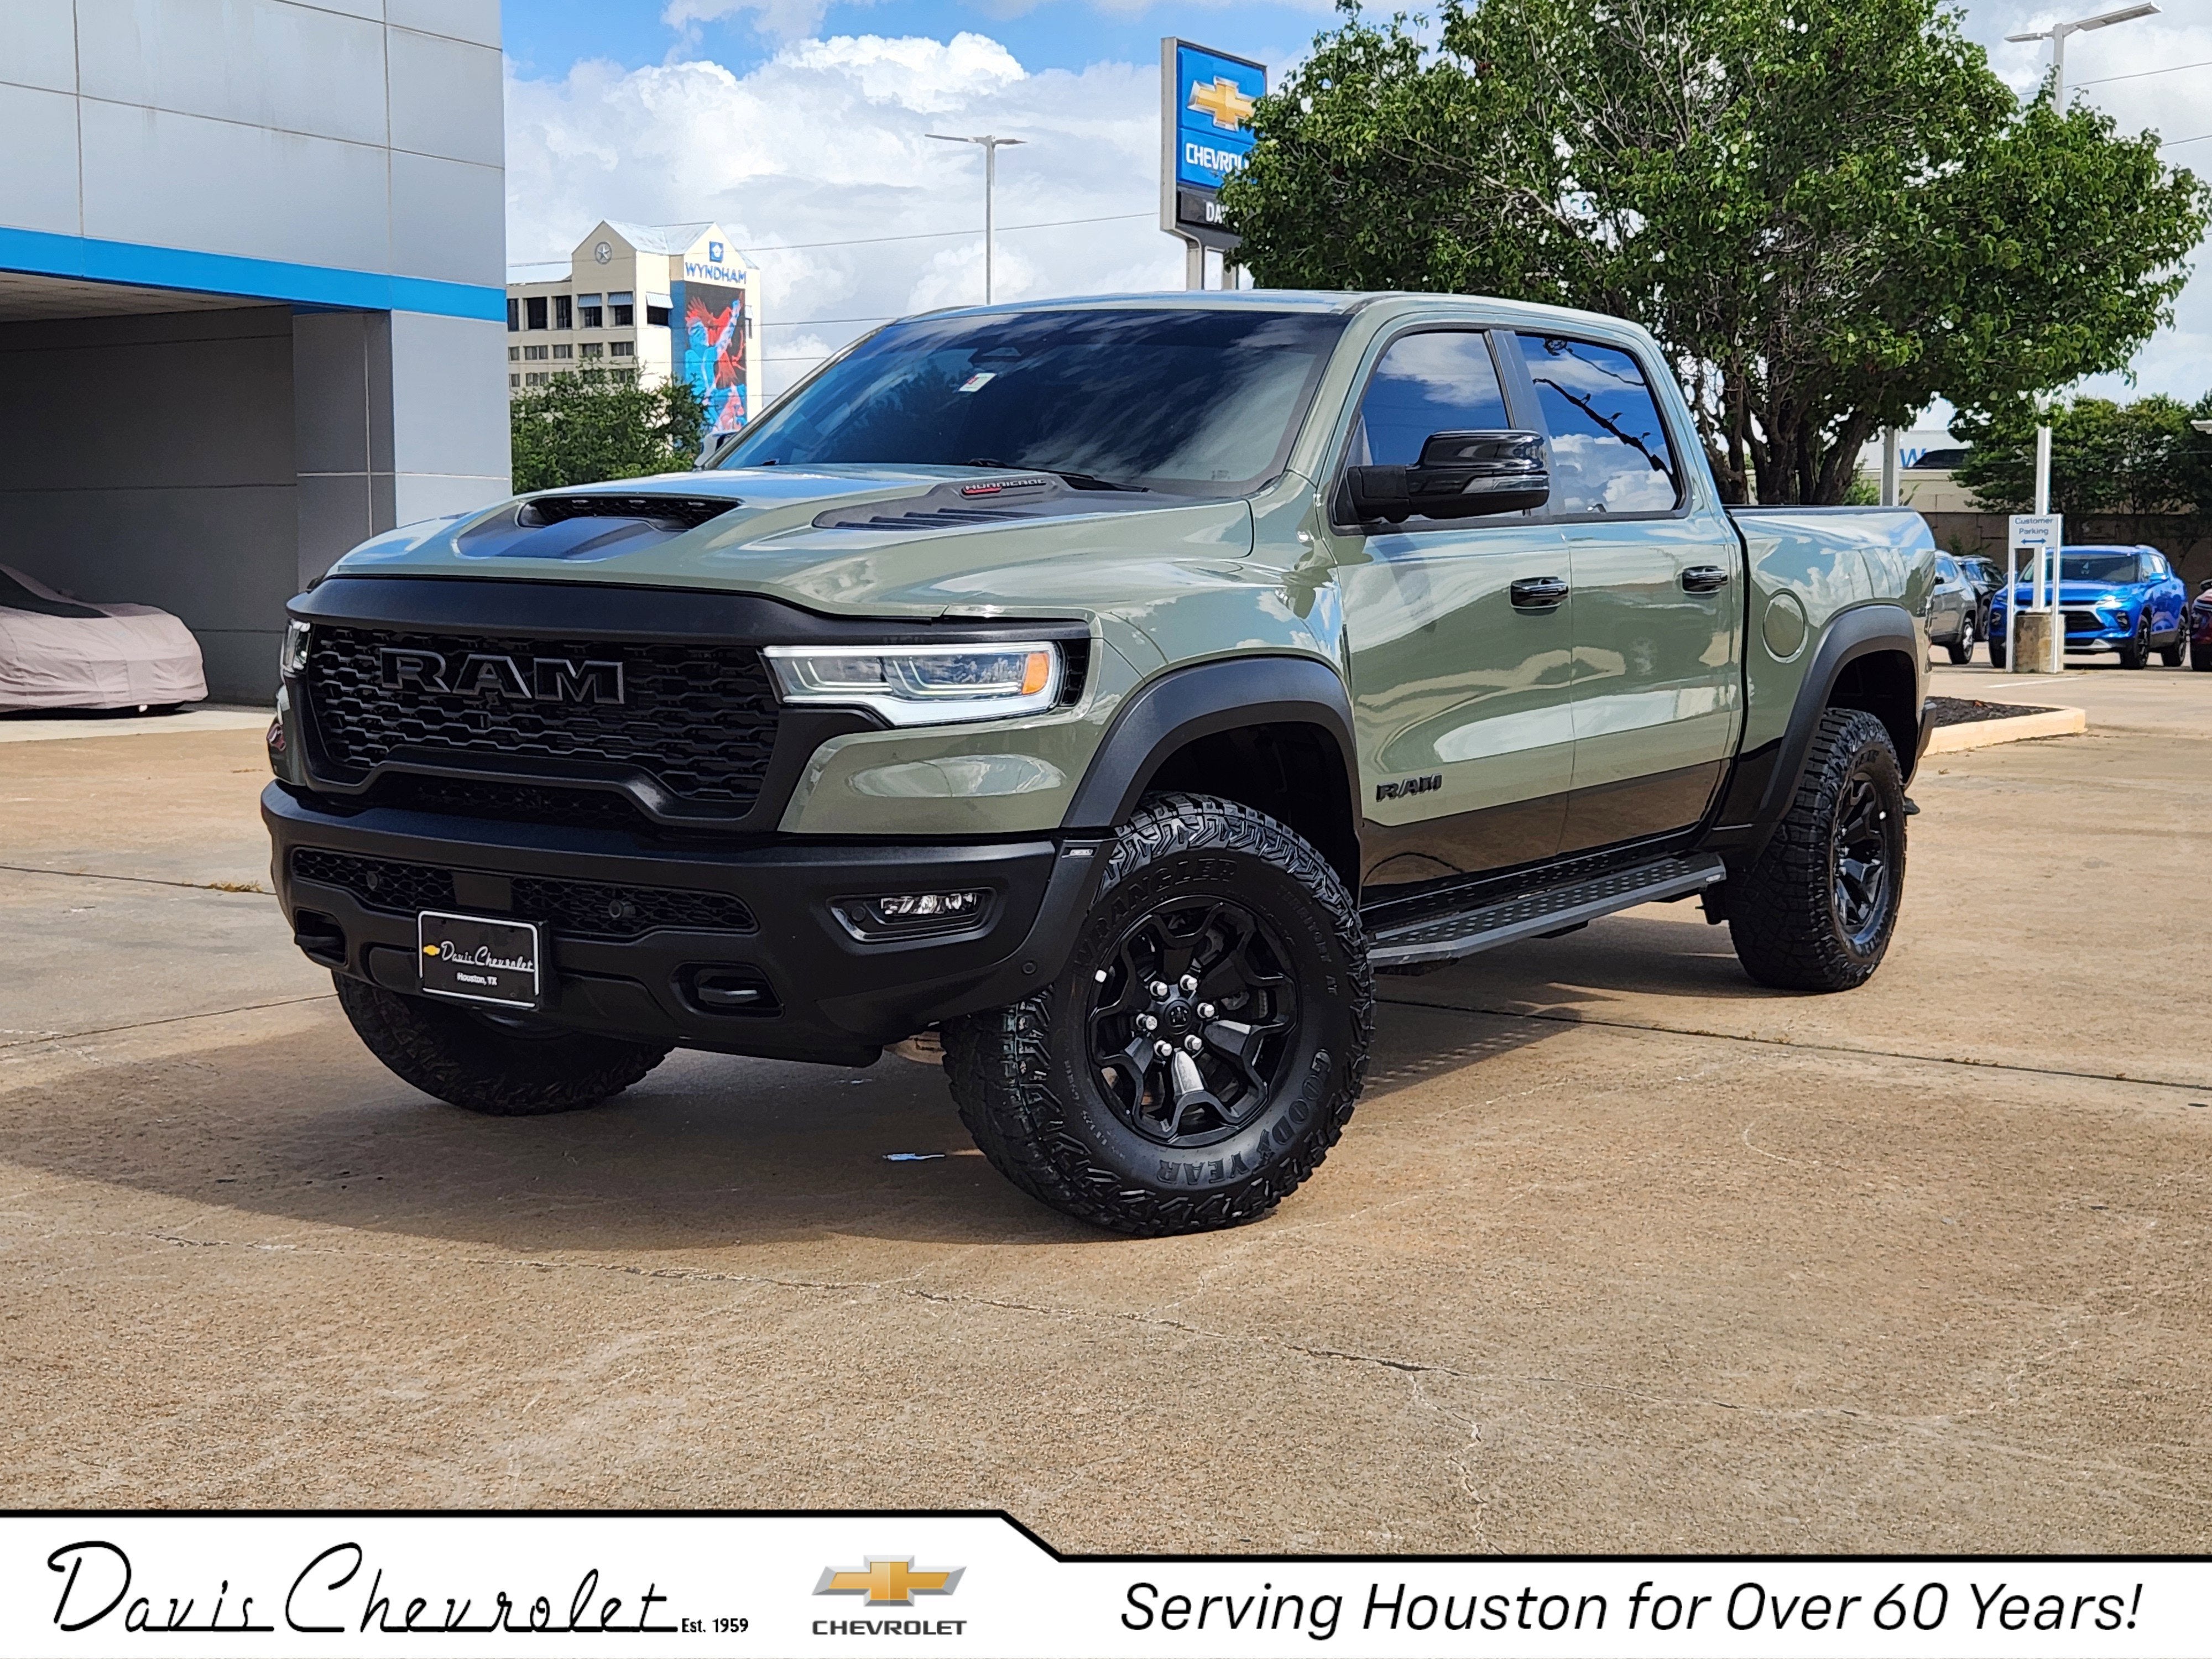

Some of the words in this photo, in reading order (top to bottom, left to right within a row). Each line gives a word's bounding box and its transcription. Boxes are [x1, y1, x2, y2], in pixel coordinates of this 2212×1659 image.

[1186, 143, 1249, 173] CHEVROL
[685, 262, 747, 284] WYNDHAM
[379, 648, 624, 705] RAM
[1376, 773, 1442, 802] RAM
[441, 941, 475, 964] Davis
[475, 946, 535, 972] Chevrolet
[457, 972, 487, 985] Houston,
[488, 976, 497, 985] TX
